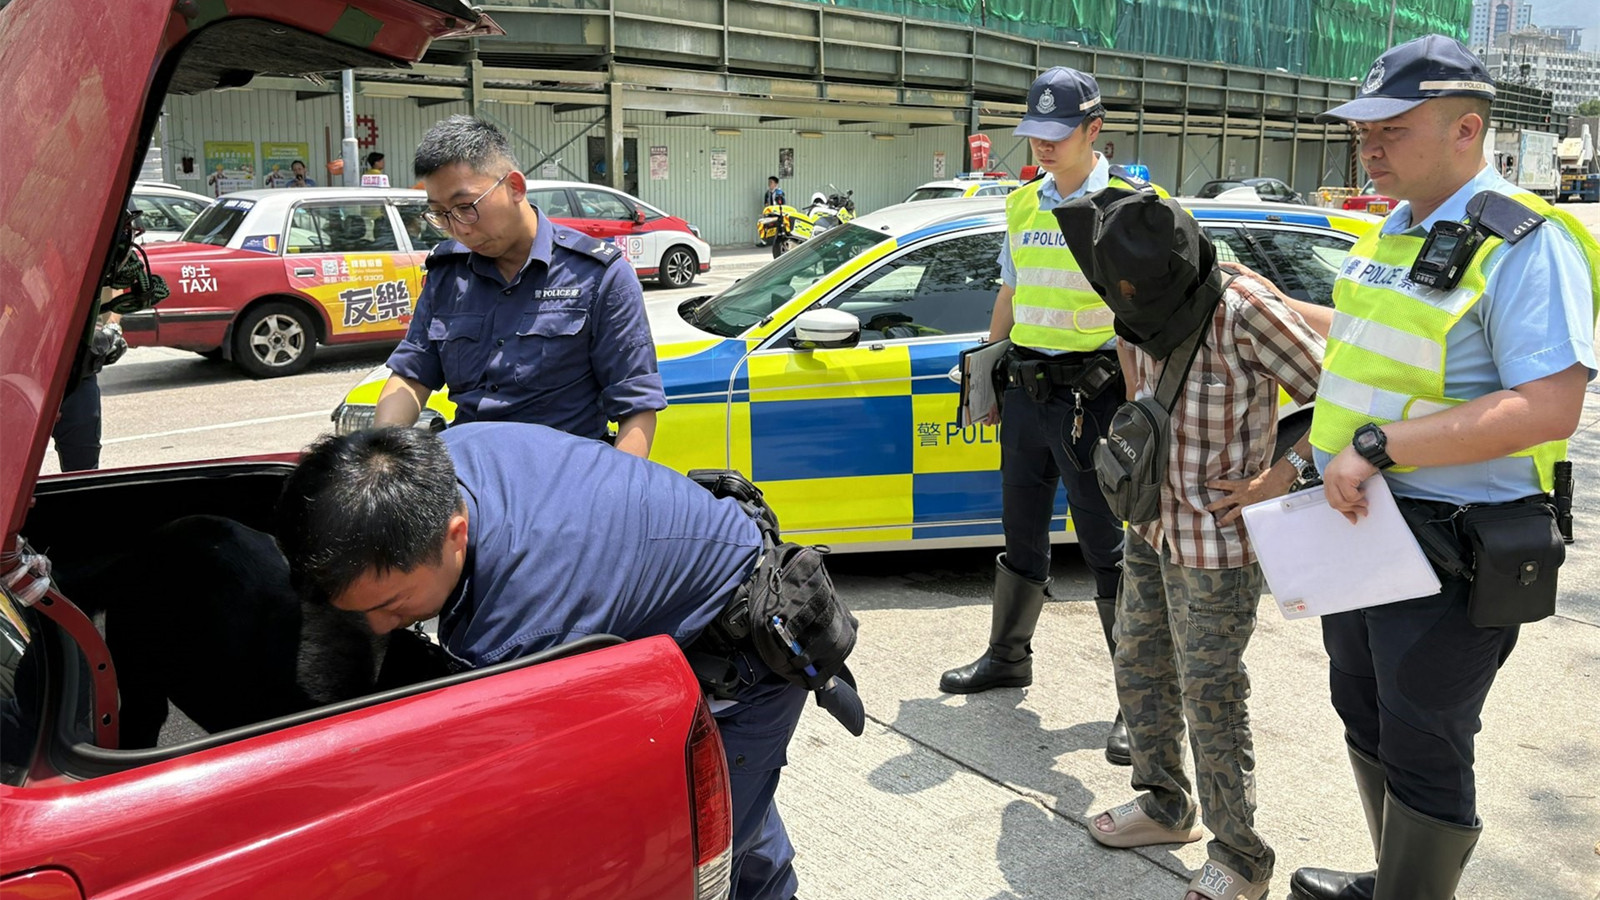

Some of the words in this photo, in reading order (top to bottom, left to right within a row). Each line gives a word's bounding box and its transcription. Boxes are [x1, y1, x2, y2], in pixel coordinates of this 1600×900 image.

[1513, 217, 1537, 236] 6111
[181, 264, 211, 278] 的士
[178, 278, 218, 294] TAXI
[543, 289, 570, 298] POLICE
[339, 280, 410, 326] 友樂
[917, 422, 941, 447] 警
[1200, 864, 1233, 894] Hi
